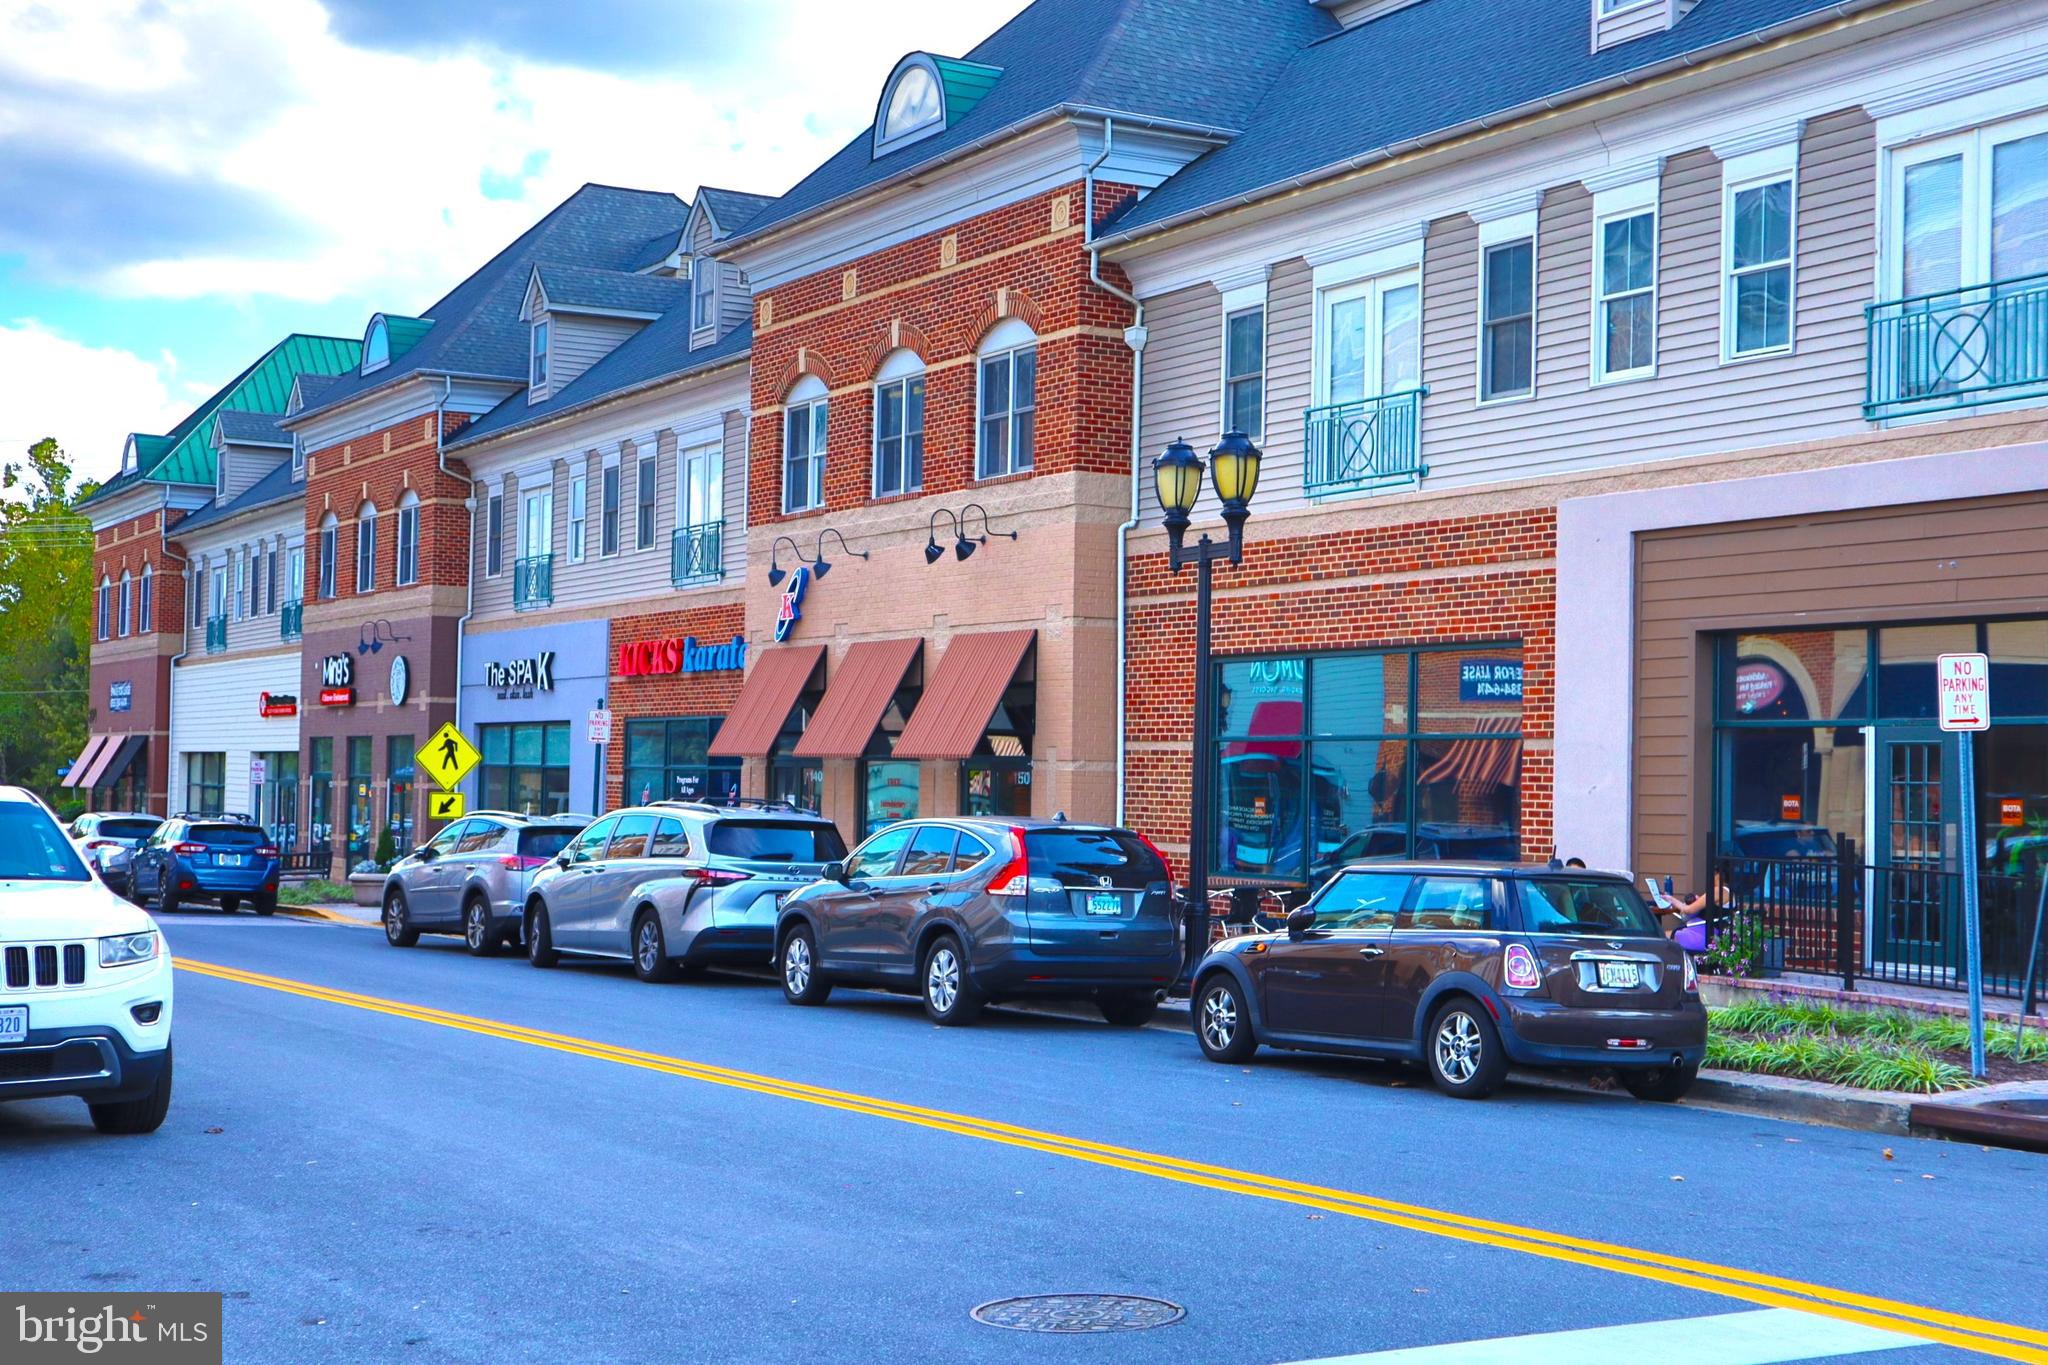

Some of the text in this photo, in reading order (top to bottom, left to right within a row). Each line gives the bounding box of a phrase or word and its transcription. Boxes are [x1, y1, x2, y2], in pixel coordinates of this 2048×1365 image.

[618, 638, 681, 676] KICKS
[322, 653, 350, 686] Ming's
[484, 652, 550, 690] The SPA K
[1954, 661, 1972, 675] NO
[1943, 677, 1985, 692] PARKING
[1954, 693, 1973, 703] ANY
[1953, 704, 1976, 714] TIME
